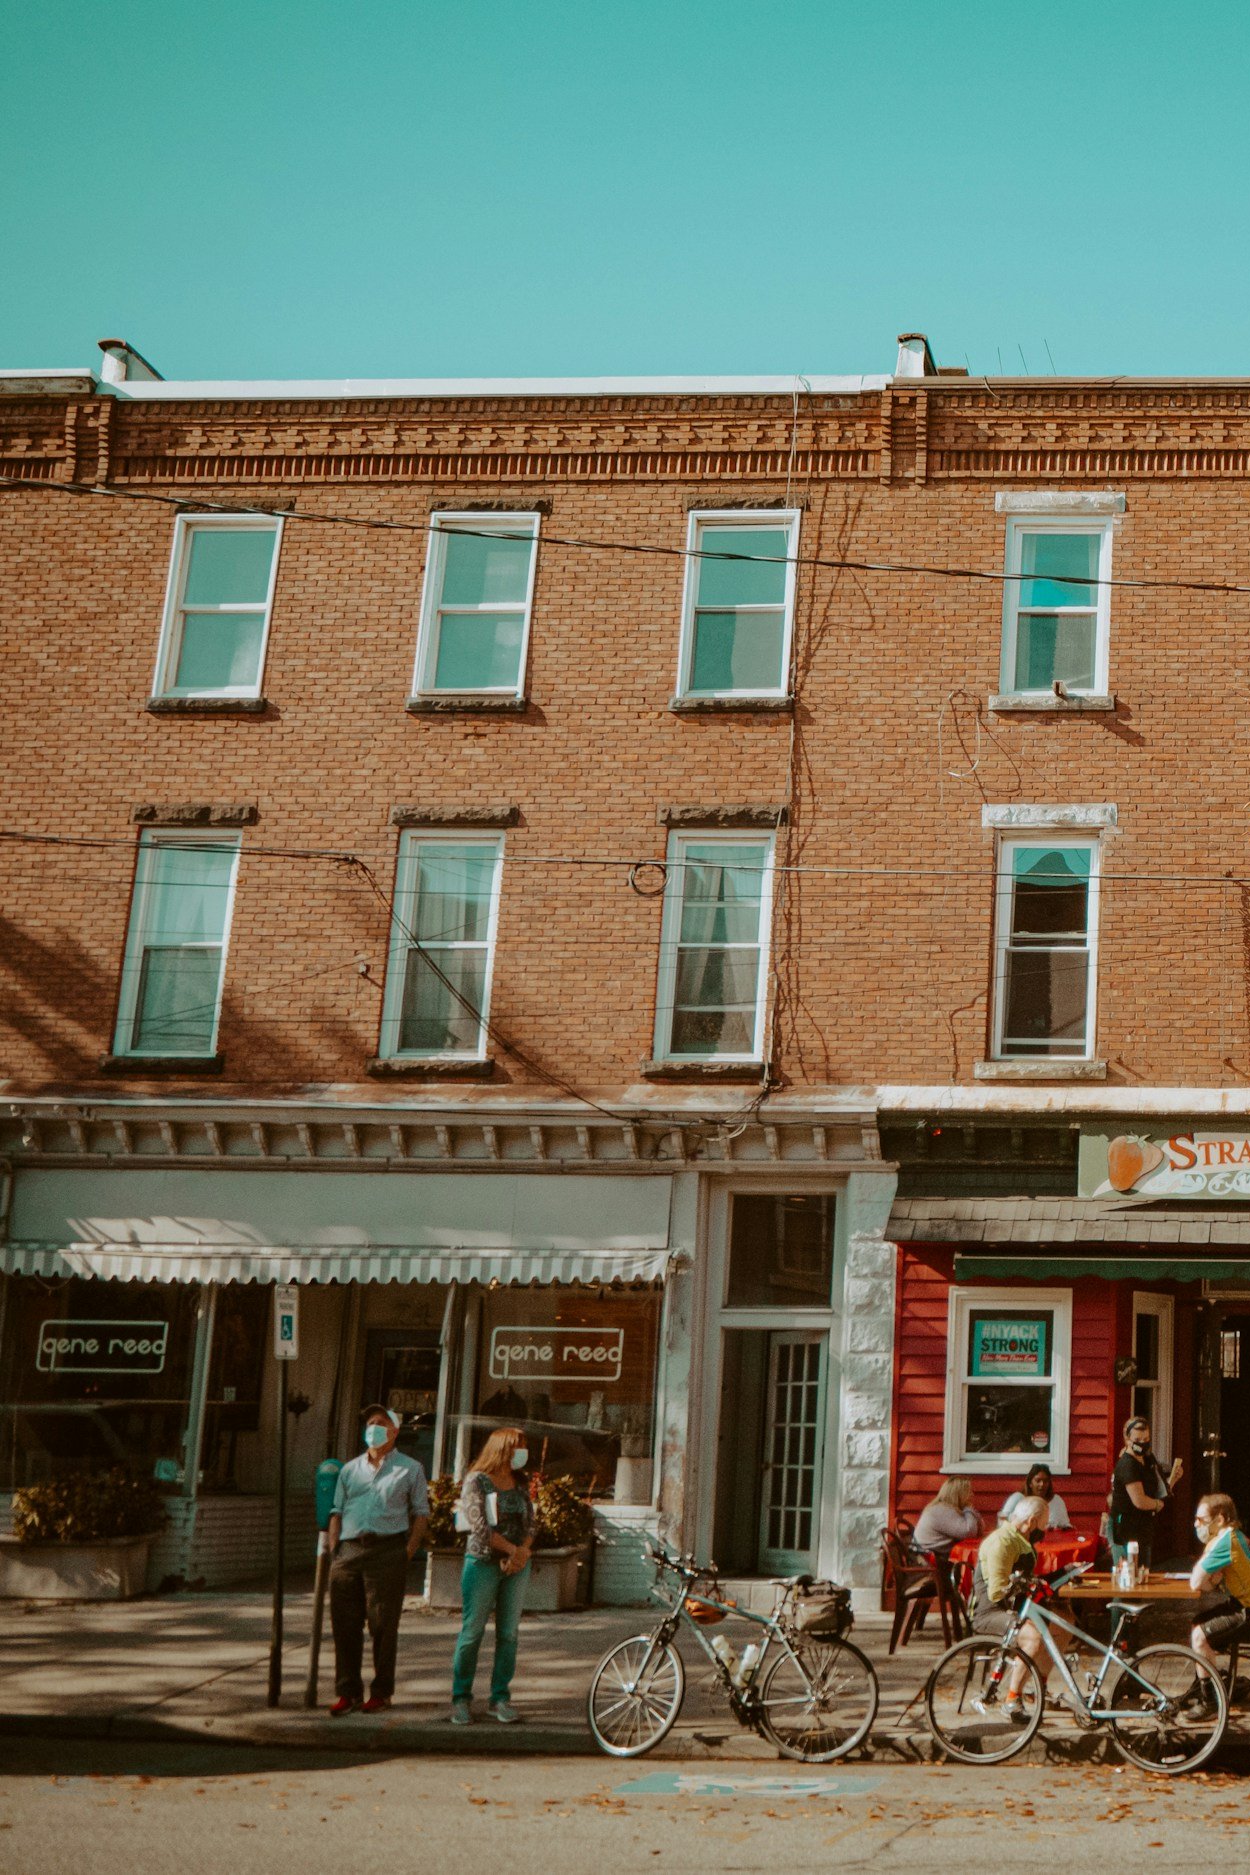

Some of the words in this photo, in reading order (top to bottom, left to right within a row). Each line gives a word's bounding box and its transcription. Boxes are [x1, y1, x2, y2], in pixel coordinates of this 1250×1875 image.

[982, 1324, 1039, 1339] #NYACK
[43, 1338, 99, 1372] gene
[981, 1338, 1039, 1352] STRONG
[495, 1345, 553, 1378] gene
